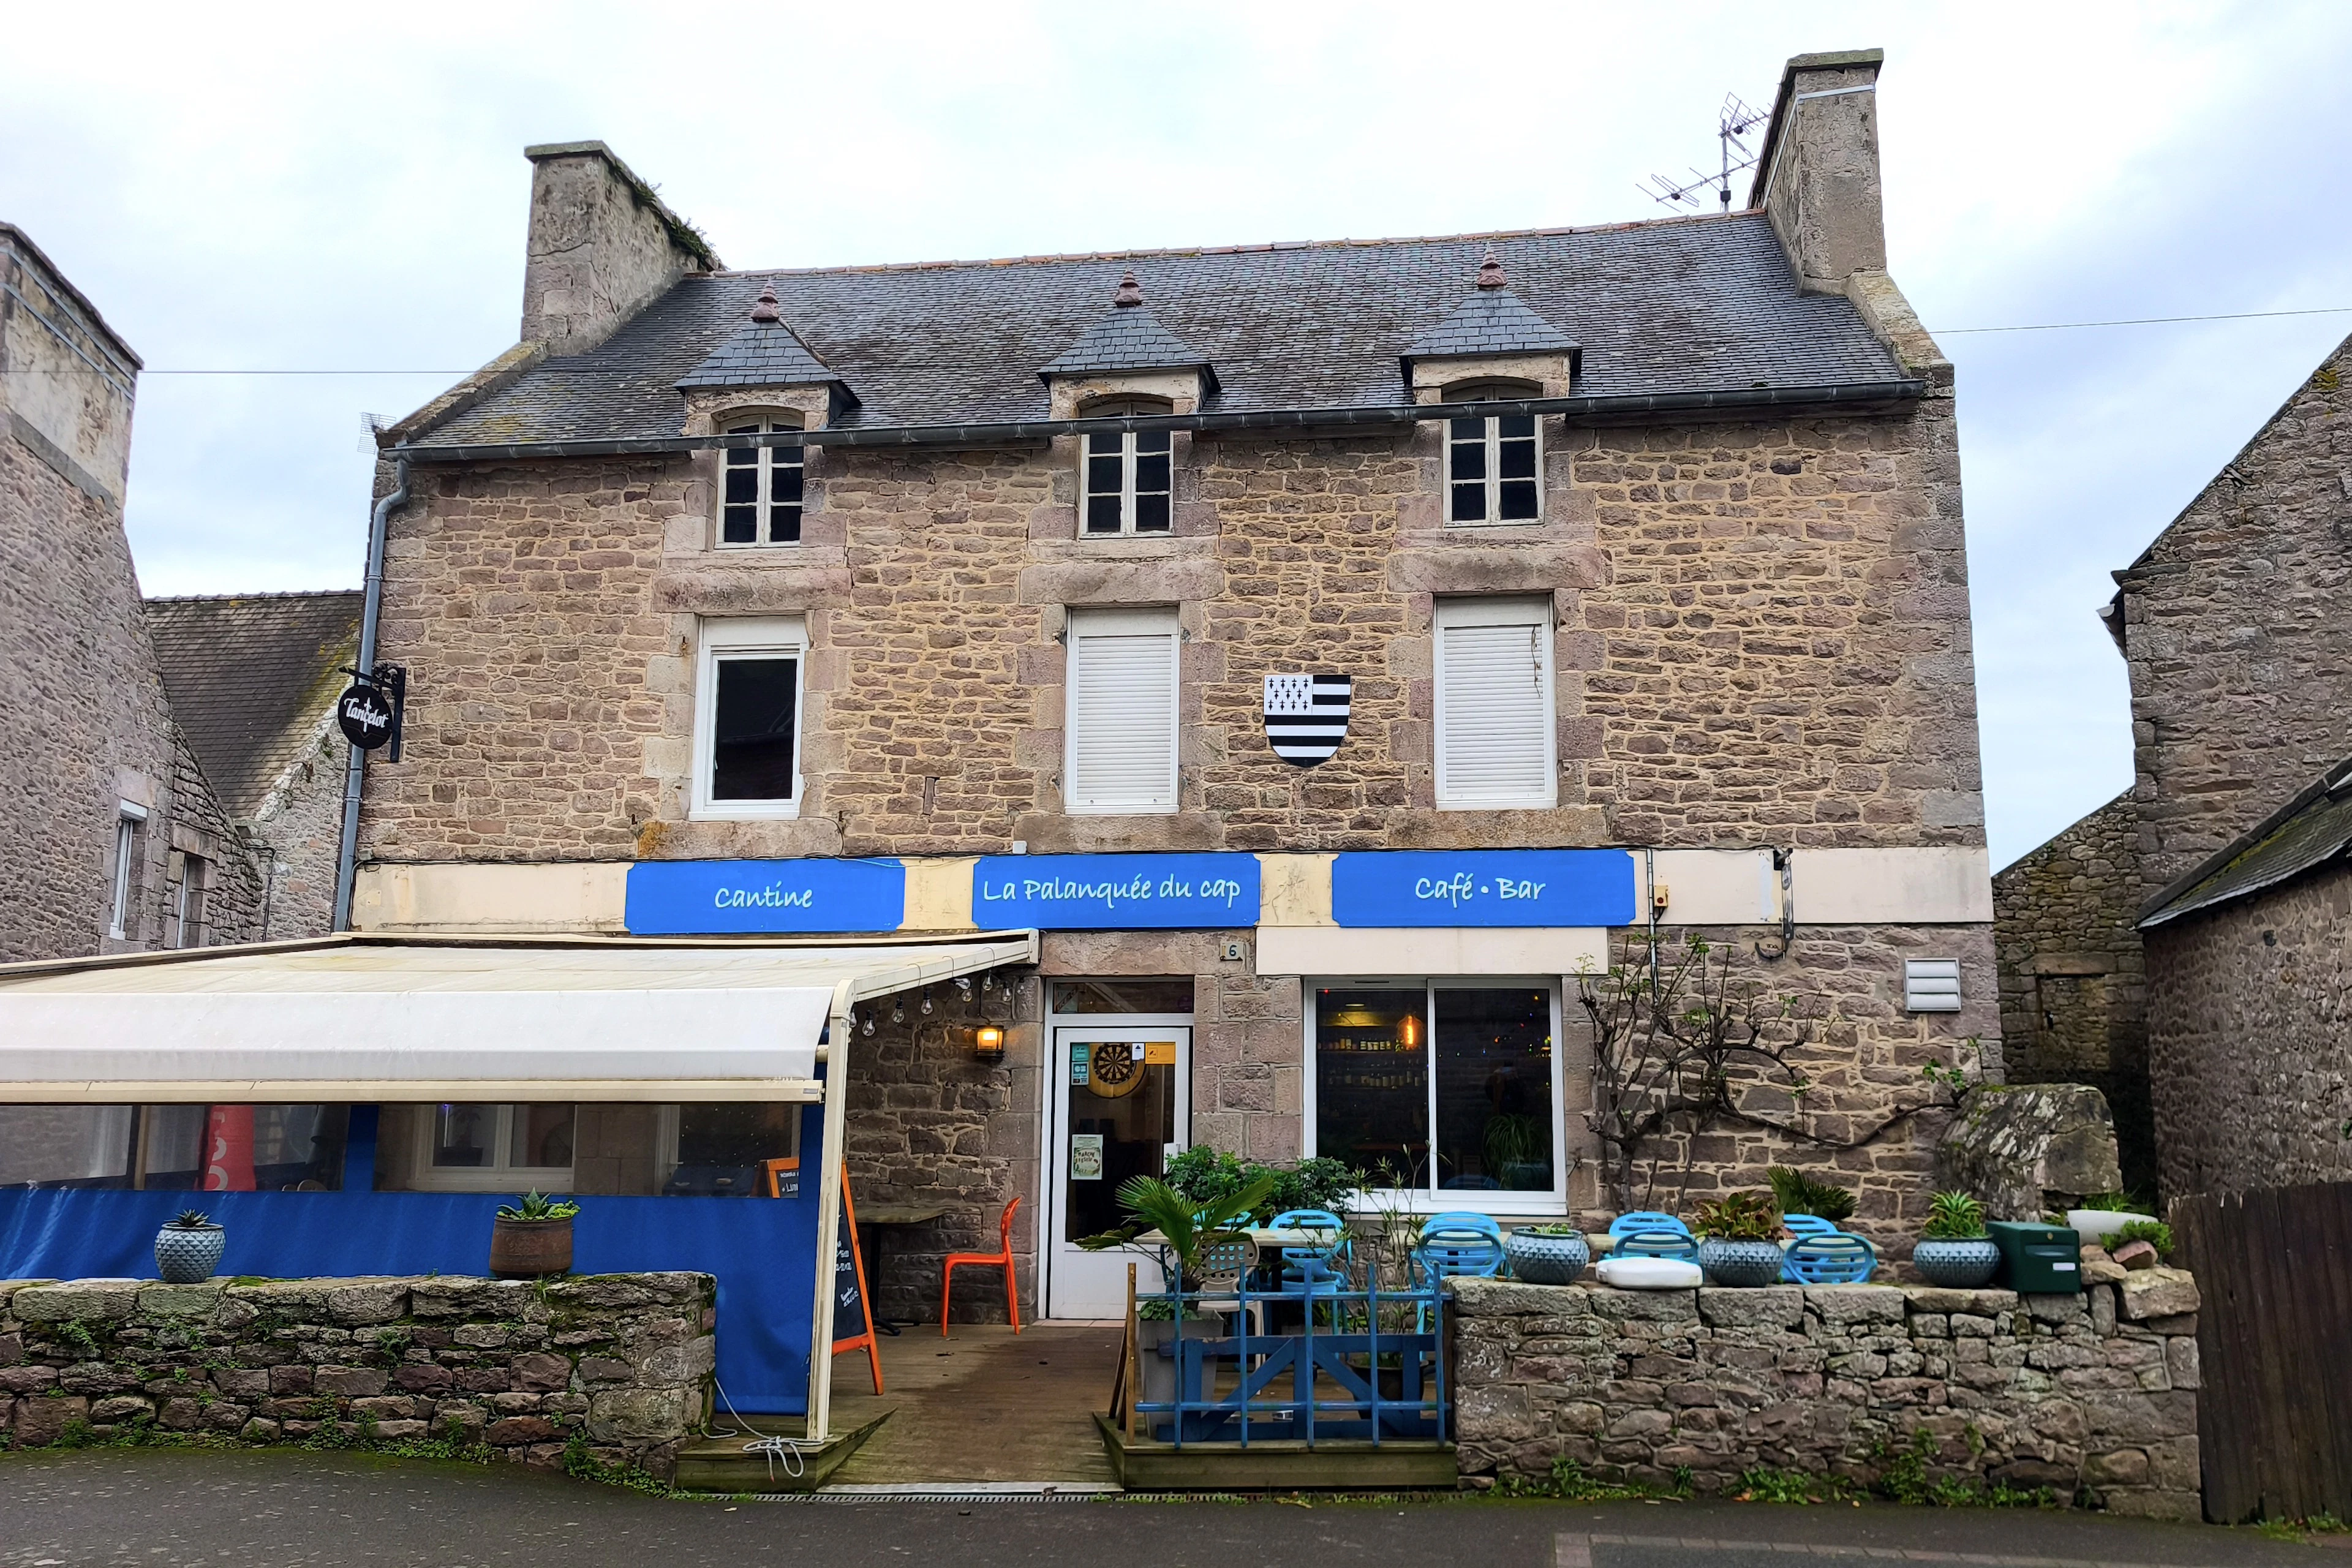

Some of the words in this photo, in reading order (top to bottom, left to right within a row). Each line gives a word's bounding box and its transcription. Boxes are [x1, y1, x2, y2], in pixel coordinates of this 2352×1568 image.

[715, 881, 812, 908] Cantine
[984, 881, 1016, 900] La
[1023, 873, 1152, 909] Palanquée
[1159, 873, 1193, 898] du
[1200, 879, 1240, 908] cap
[1415, 872, 1474, 908] Café
[1495, 878, 1546, 900] Bar
[1229, 944, 1237, 957] 6
